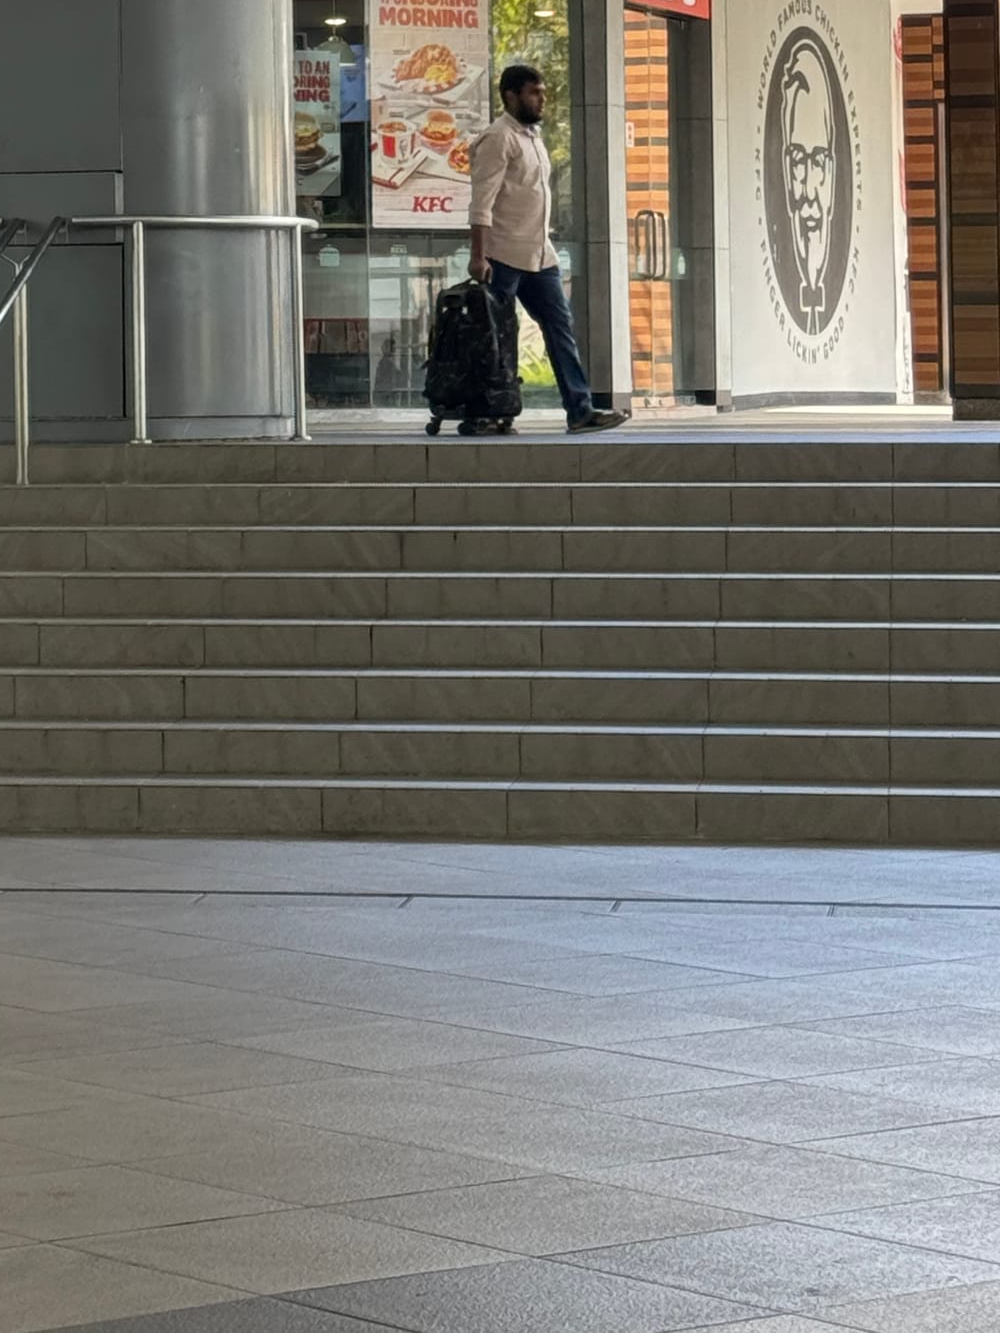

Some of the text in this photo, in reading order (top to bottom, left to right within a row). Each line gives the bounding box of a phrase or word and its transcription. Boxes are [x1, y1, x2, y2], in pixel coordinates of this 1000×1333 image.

[378, 7, 479, 28] MORNING
[298, 59, 330, 75] TO AN
[757, 29, 777, 110] WORLD
[815, 4, 849, 82] CHICKEN
[412, 196, 453, 213] KFC
[823, 316, 844, 360] GOOD
